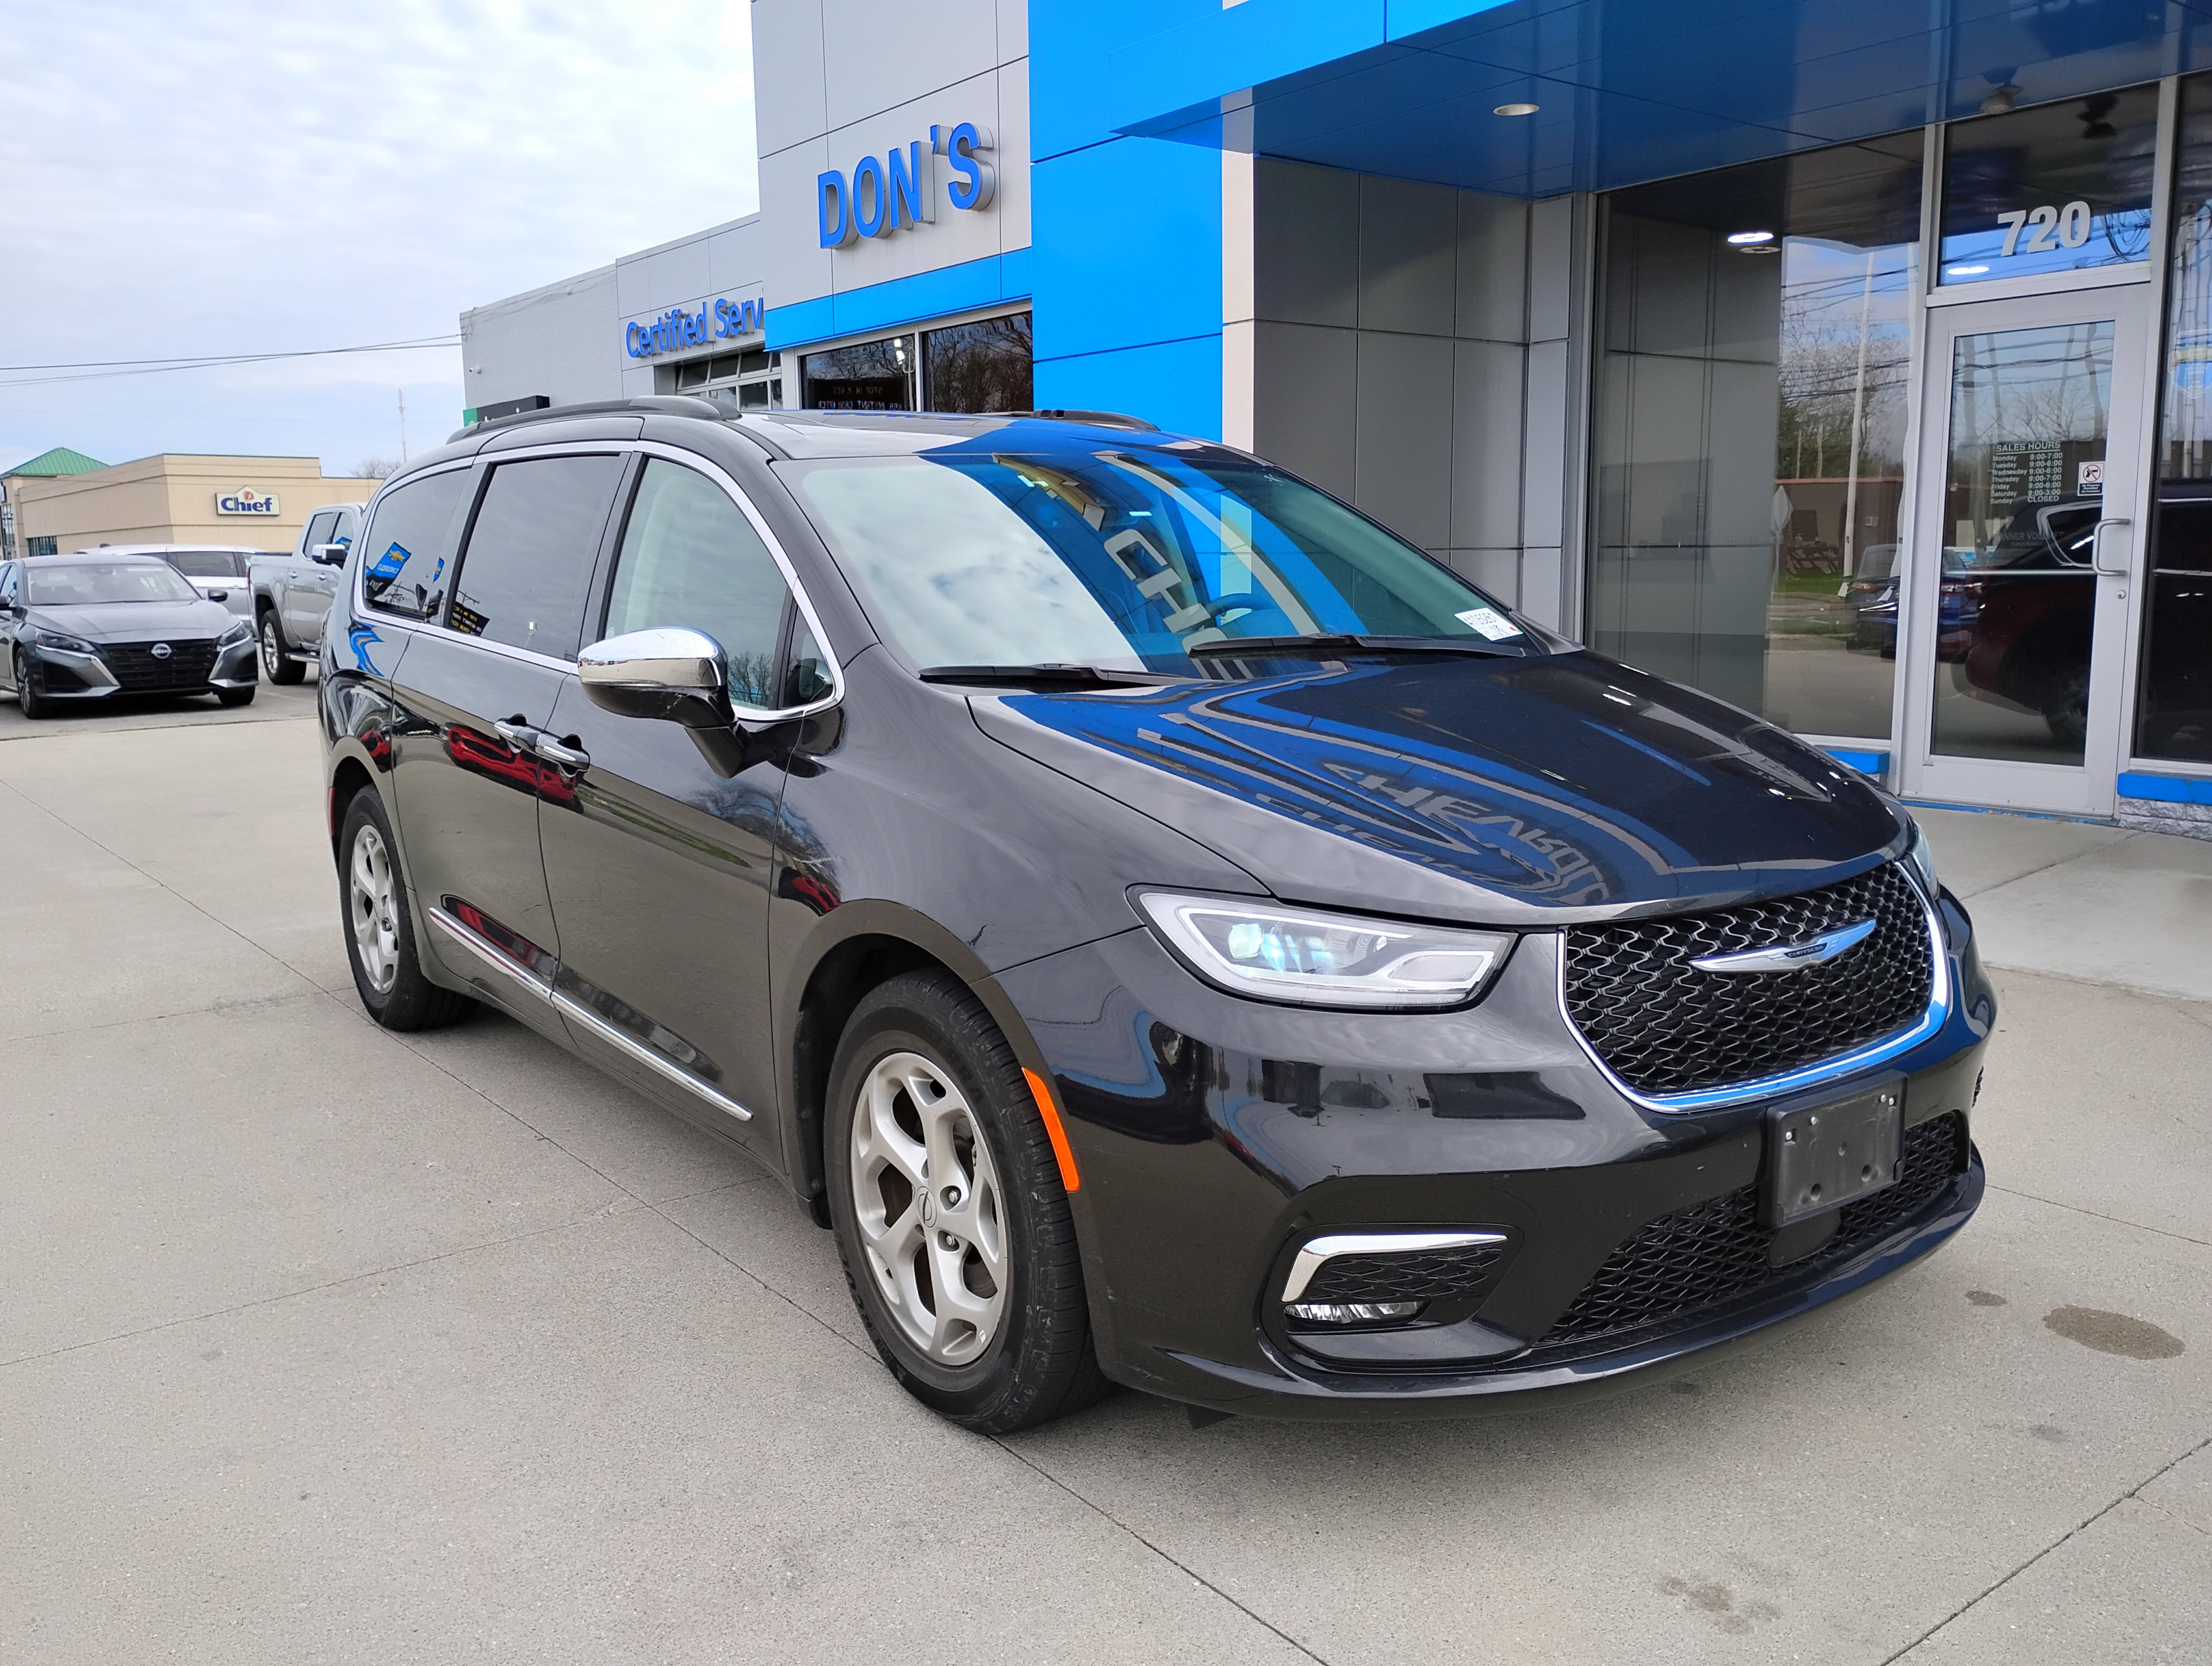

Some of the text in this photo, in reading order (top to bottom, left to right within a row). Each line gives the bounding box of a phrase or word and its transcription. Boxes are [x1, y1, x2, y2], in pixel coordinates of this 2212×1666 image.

[818, 123, 989, 249] DON'S
[1997, 201, 2091, 257] 720
[626, 302, 708, 358] Certified
[1996, 441, 2061, 452] SALES HOURS
[221, 497, 272, 512] Chief
[1788, 945, 1824, 957] CHRYSLER
